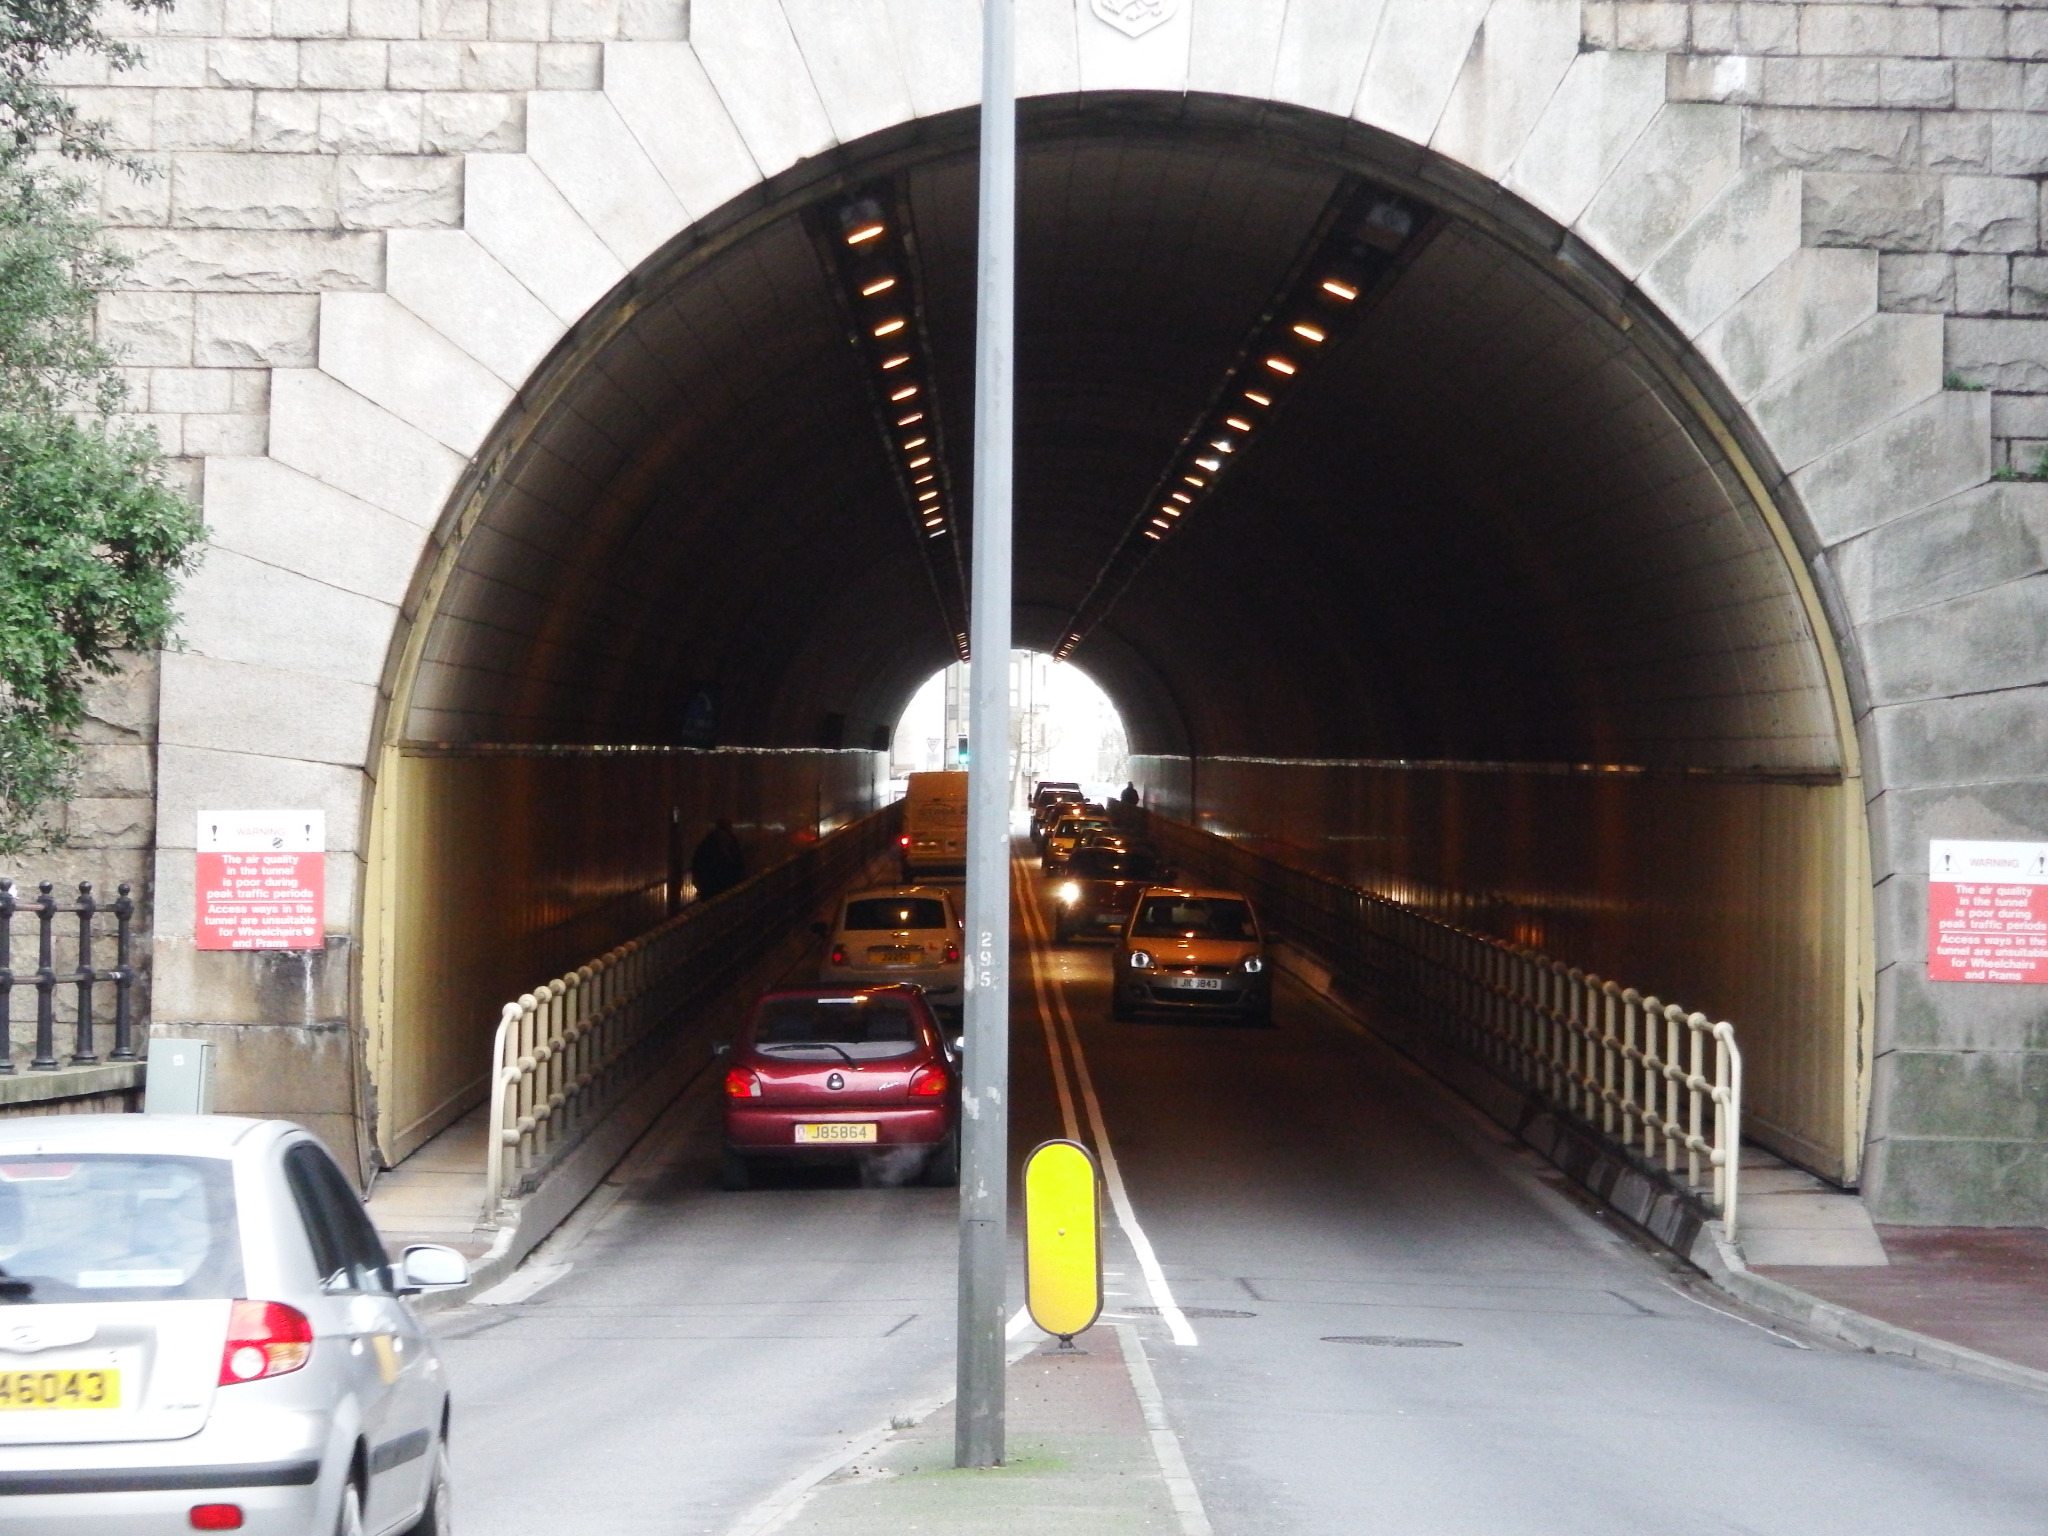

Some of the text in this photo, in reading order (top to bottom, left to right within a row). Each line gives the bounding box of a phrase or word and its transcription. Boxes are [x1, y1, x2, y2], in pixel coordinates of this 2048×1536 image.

[222, 855, 299, 865] The air quality
[1970, 858, 2019, 868] WARNING
[226, 867, 294, 875] in the tunnel
[222, 878, 298, 889] is poor during
[206, 889, 314, 899] peak traffic periods
[1955, 885, 2032, 897] The air quality
[1960, 897, 2028, 907] in the tunnel
[208, 905, 313, 915] Access ways in the
[1955, 908, 2032, 920] is poor during
[205, 916, 236, 925] tunnel
[262, 916, 316, 925] unsuitable
[1939, 920, 2047, 931] peak traffic periods
[219, 927, 303, 936] for Wheelchairs
[232, 939, 288, 948] and Prams
[1941, 935, 2047, 947] Access ways in the
[1937, 947, 1970, 955] tunnel
[1951, 958, 2035, 969] for Wheelchairs
[1964, 971, 2022, 981] and Prams
[811, 1126, 867, 1139] J85864
